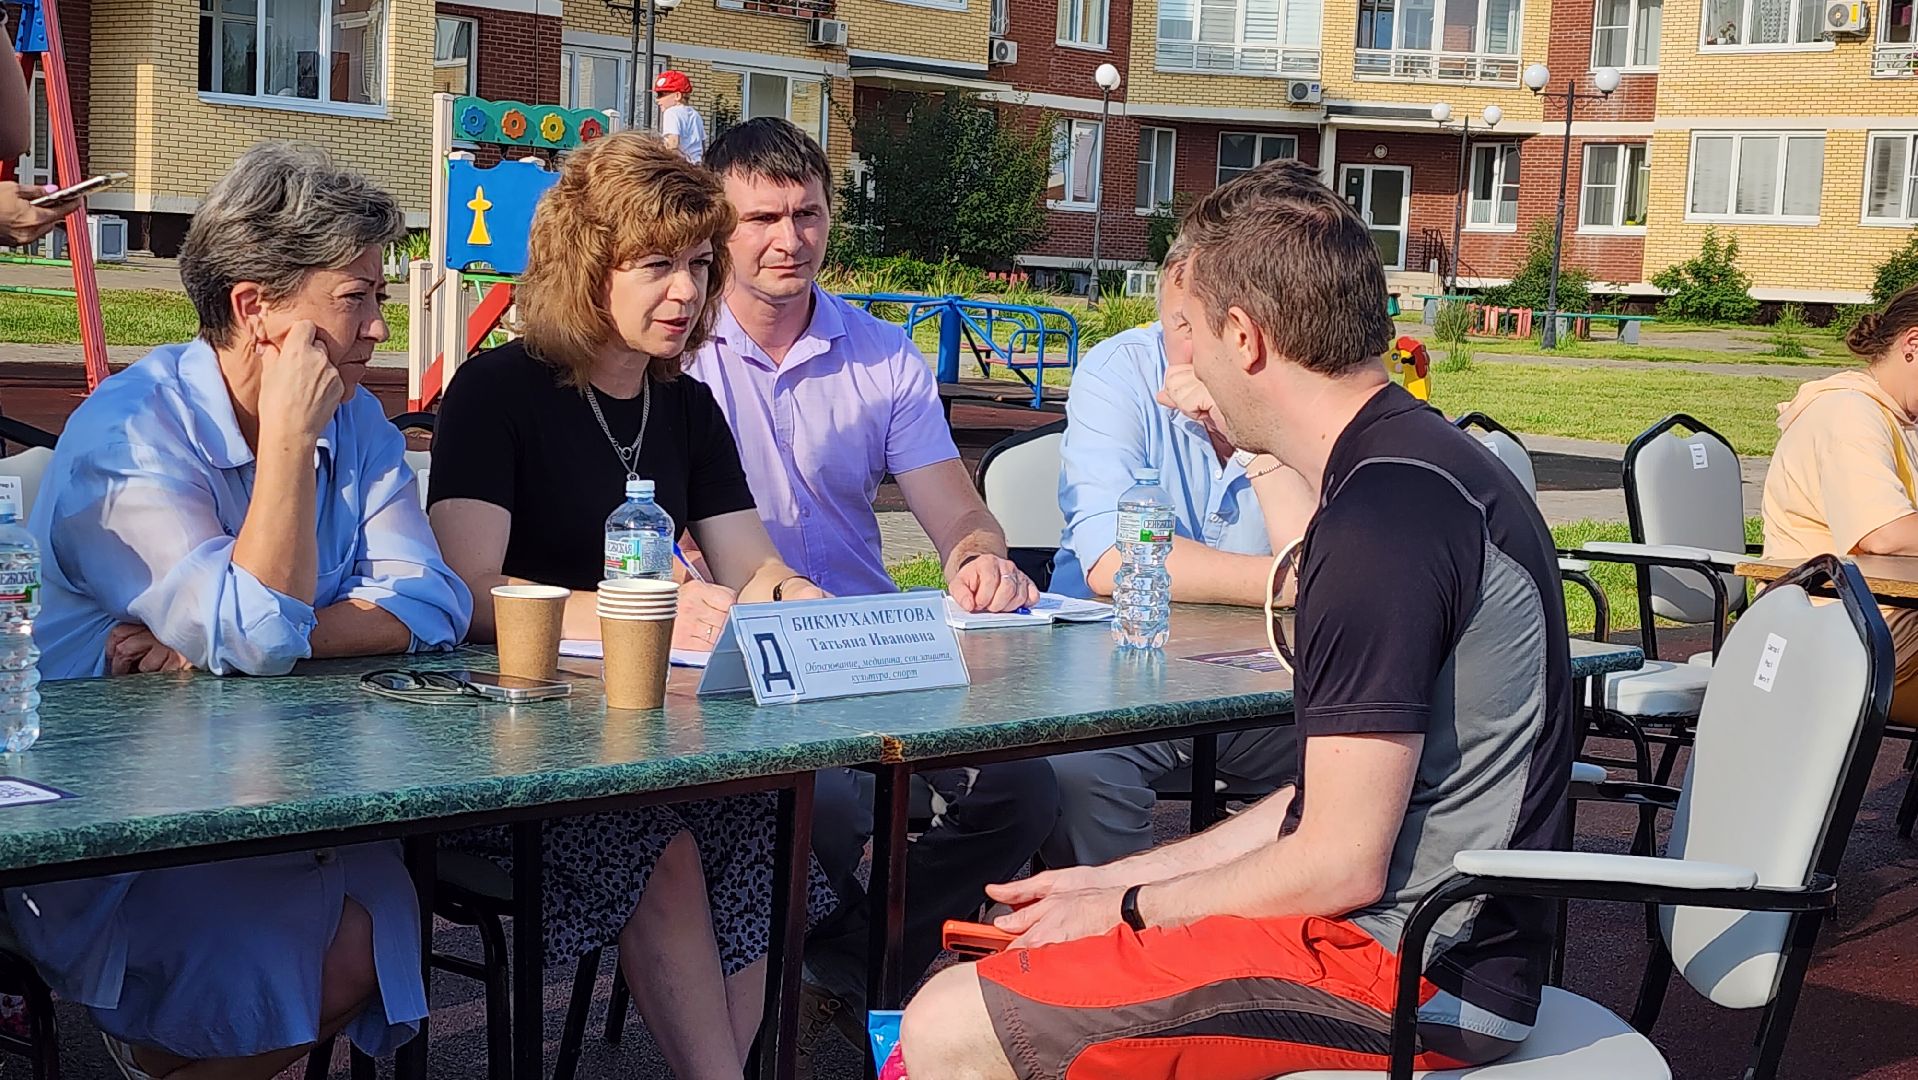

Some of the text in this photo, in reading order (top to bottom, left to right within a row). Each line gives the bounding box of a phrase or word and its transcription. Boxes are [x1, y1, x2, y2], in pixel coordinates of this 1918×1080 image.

[791, 607, 936, 632] БИКМУХАМЕТОВА
[807, 632, 936, 652] Татьяна Ивановна
[753, 632, 796, 692] Д
